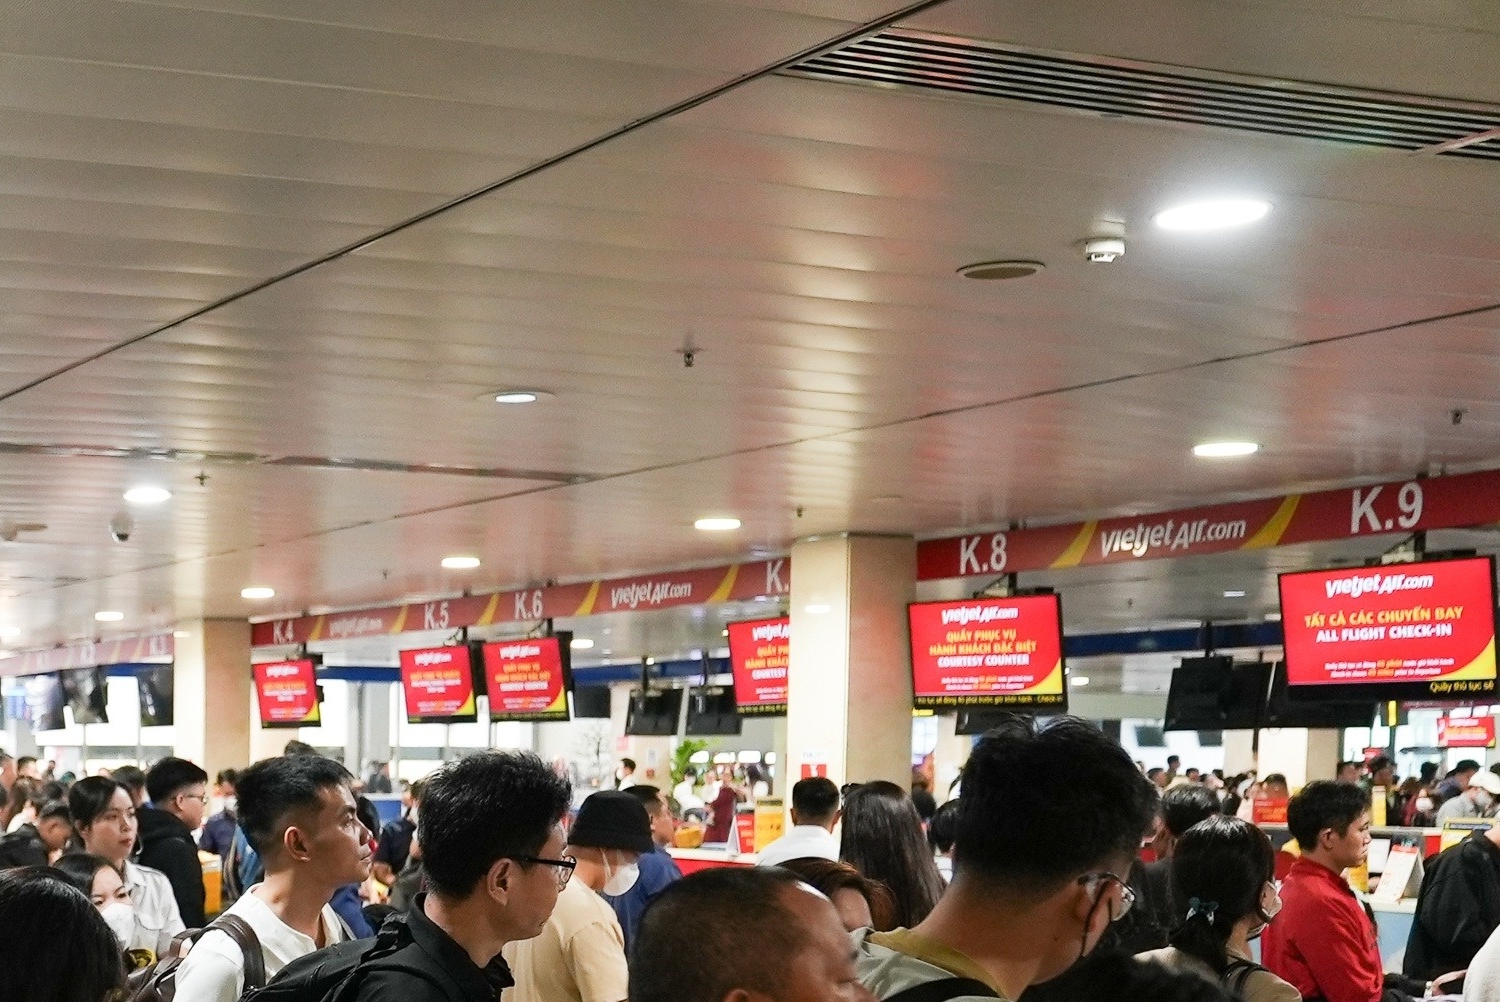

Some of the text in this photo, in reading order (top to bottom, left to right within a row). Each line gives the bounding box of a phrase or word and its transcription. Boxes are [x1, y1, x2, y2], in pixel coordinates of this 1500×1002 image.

[1350, 482, 1423, 534] K.9
[959, 534, 1007, 575] K.8
[424, 601, 449, 630] K.5
[514, 592, 543, 620] K.6
[1435, 606, 1463, 620] BAY
[1316, 623, 1452, 643] ALL FLIGHT CHECK-IN
[937, 653, 1030, 668] COURTESY COUNTER
